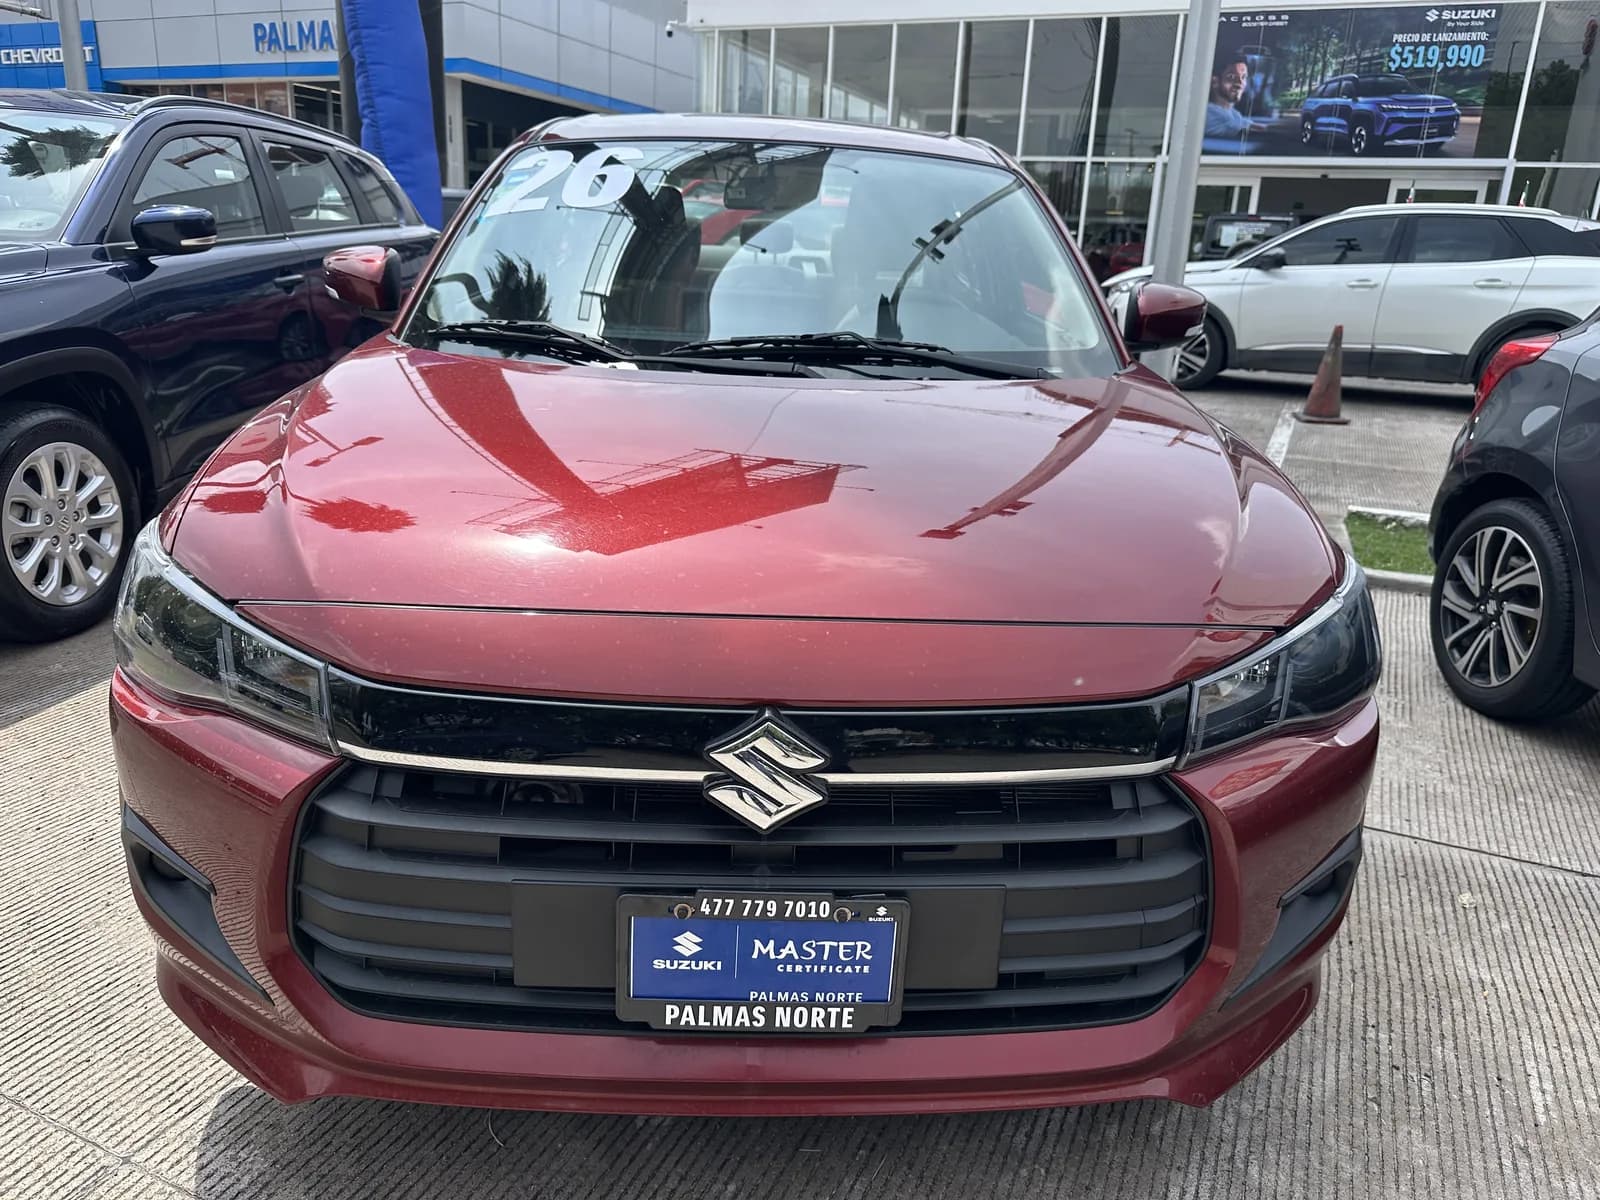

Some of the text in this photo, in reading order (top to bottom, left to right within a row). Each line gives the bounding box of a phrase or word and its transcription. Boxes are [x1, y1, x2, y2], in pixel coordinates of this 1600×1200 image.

[1441, 9, 1496, 20] SUZUKI
[253, 20, 336, 52] PALMA
[1393, 31, 1489, 42] PRECIO DE LANZAMIENTO:
[0, 46, 95, 64] CHEVROT
[1388, 43, 1486, 72] $519,990
[483, 146, 644, 217] 26
[700, 898, 830, 918] 477 779 7010
[751, 938, 873, 961] MASTER
[652, 959, 722, 971] SUZUKI
[776, 964, 871, 974] CERTIFICATE
[749, 991, 863, 1002] PALMAS NORTE
[665, 1004, 855, 1028] PALMAS NORTE
